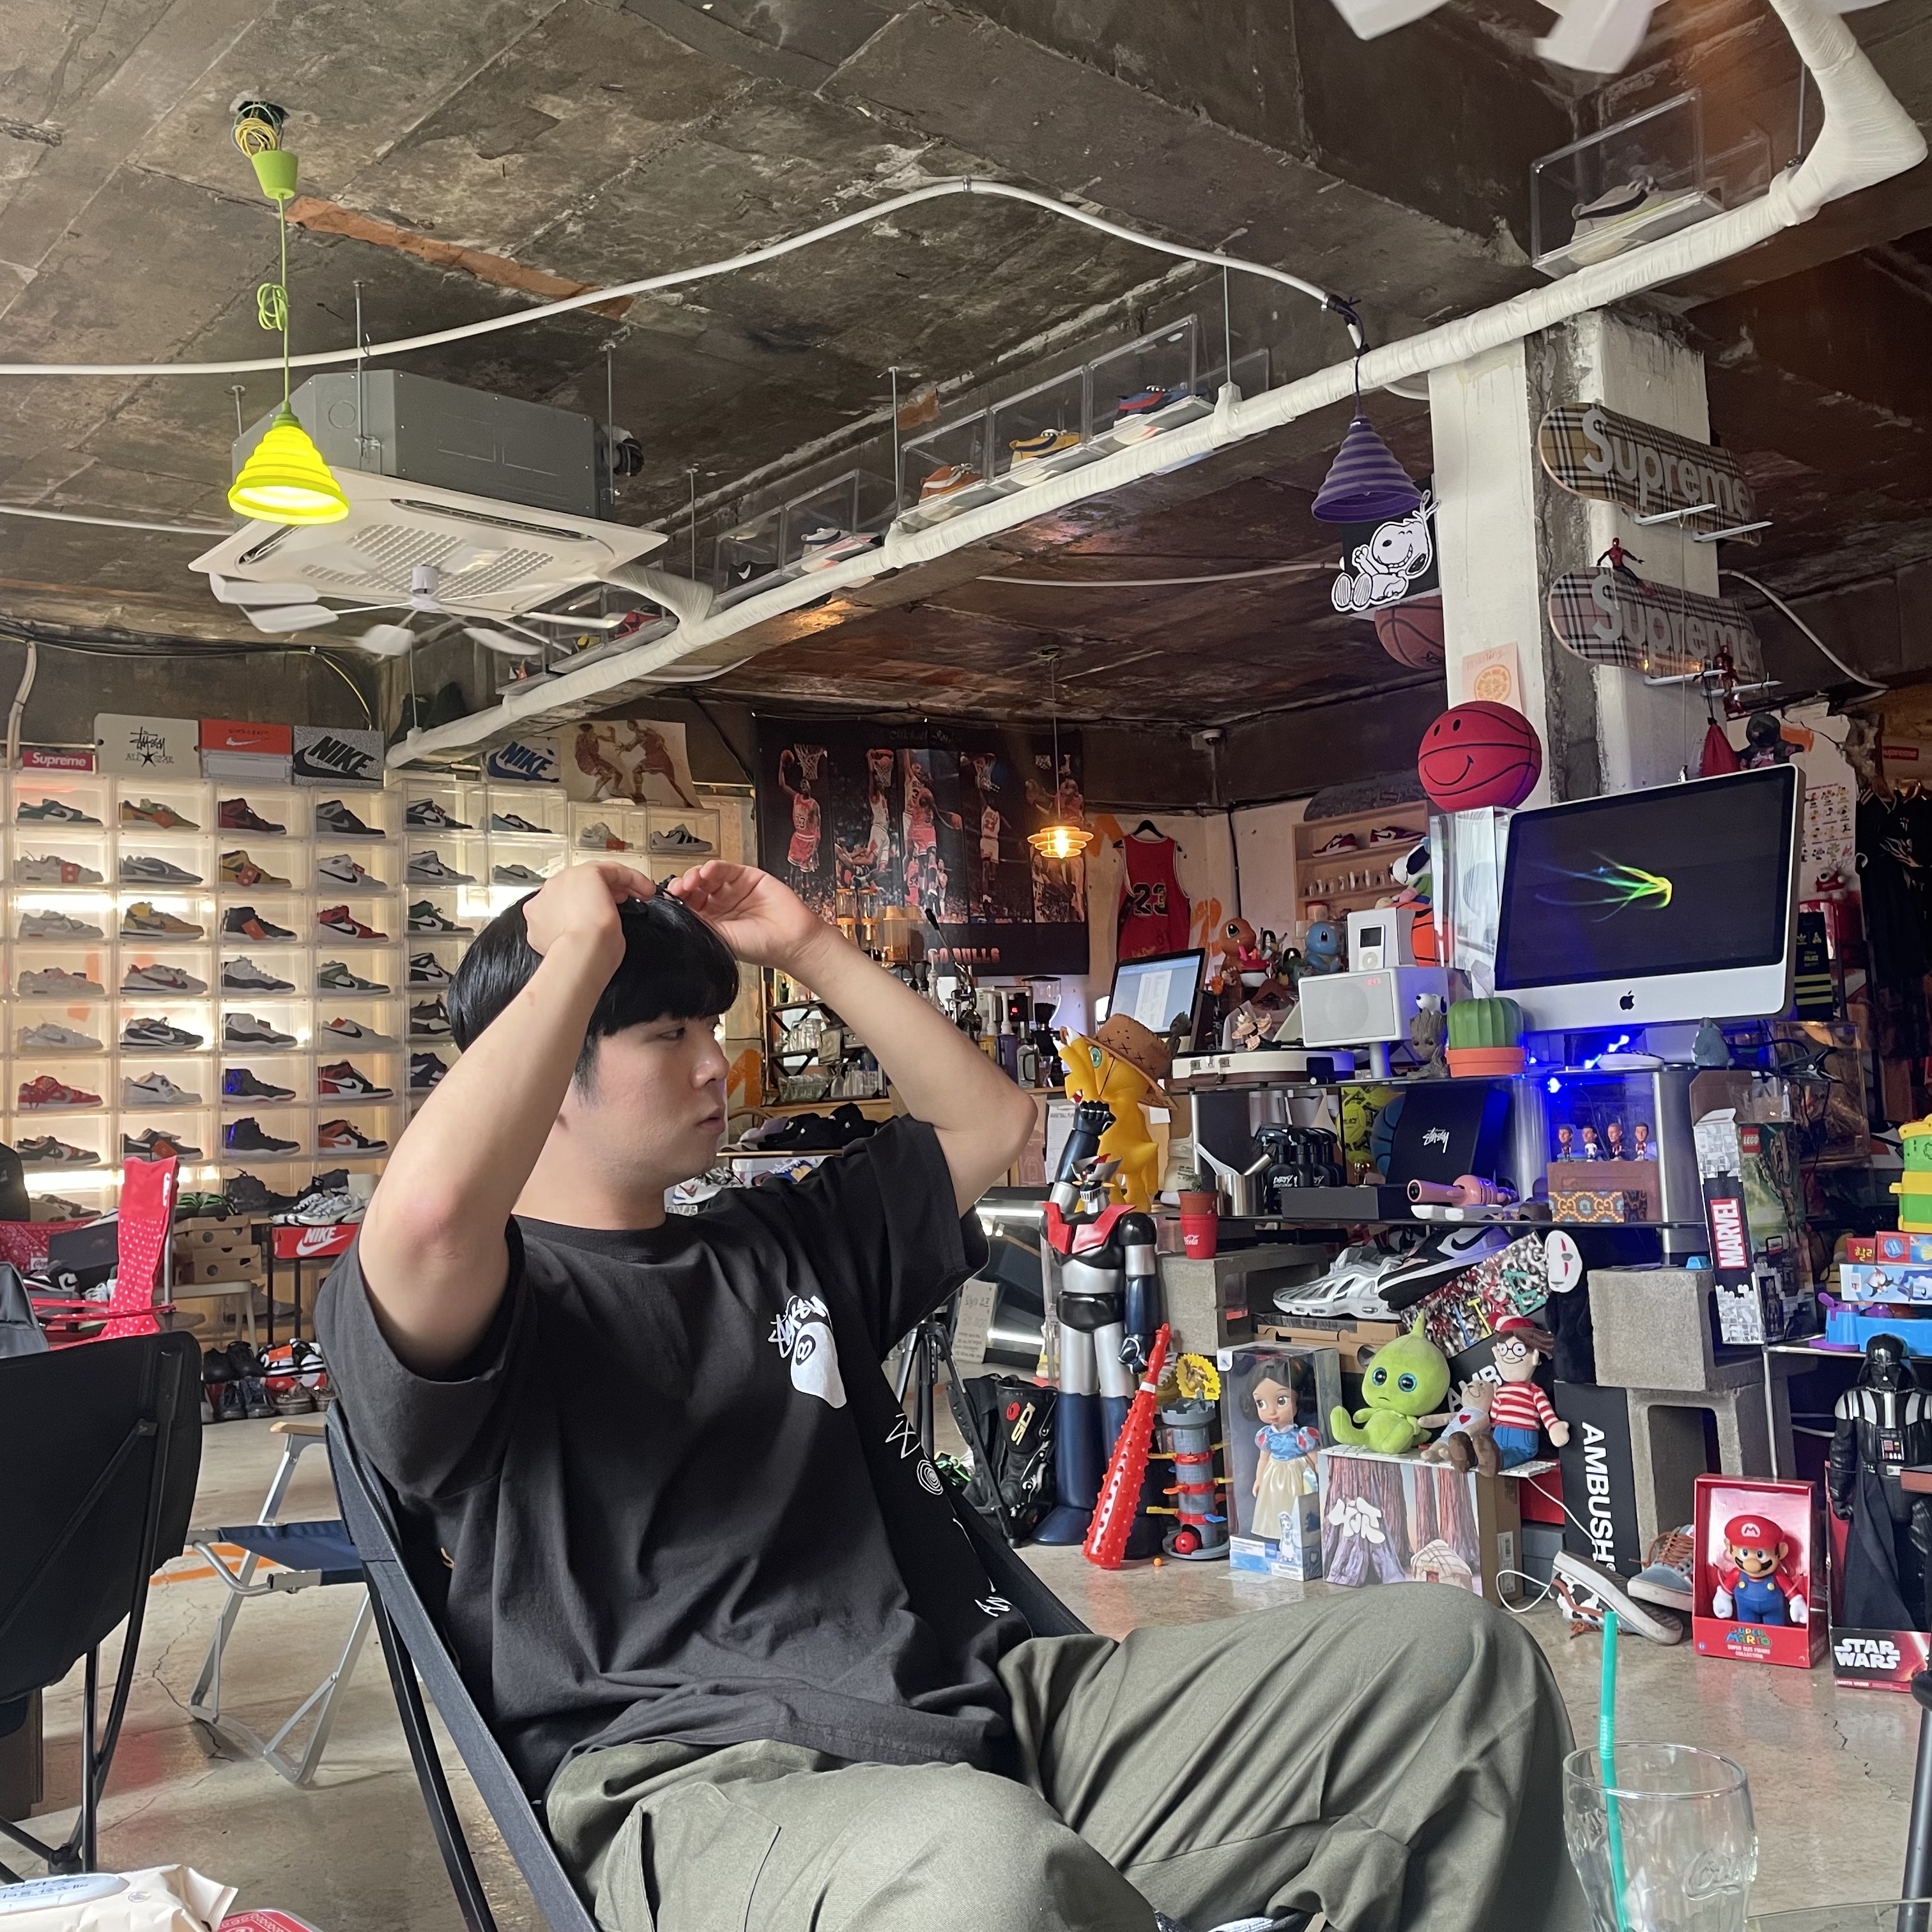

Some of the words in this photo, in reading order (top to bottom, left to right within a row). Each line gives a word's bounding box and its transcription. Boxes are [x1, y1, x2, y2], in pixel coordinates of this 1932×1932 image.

[1583, 409, 1751, 518] Supreme
[1591, 574, 1759, 671] Supreme
[33, 752, 86, 767] Supreme
[308, 736, 376, 776] NIKE
[499, 741, 553, 778] NIKE
[1883, 749, 1917, 759] upreme
[1133, 882, 1168, 917] 23
[1744, 1135, 1758, 1146] LEGO
[303, 1227, 337, 1243] NIKE
[1713, 1200, 1745, 1266] MARVEL
[1744, 1526, 1758, 1535] M
[1730, 1625, 1765, 1637] SUPER
[1726, 1633, 1772, 1647] MARIO
[1834, 1638, 1900, 1656] STAR
[1835, 1652, 1901, 1669] WARS
